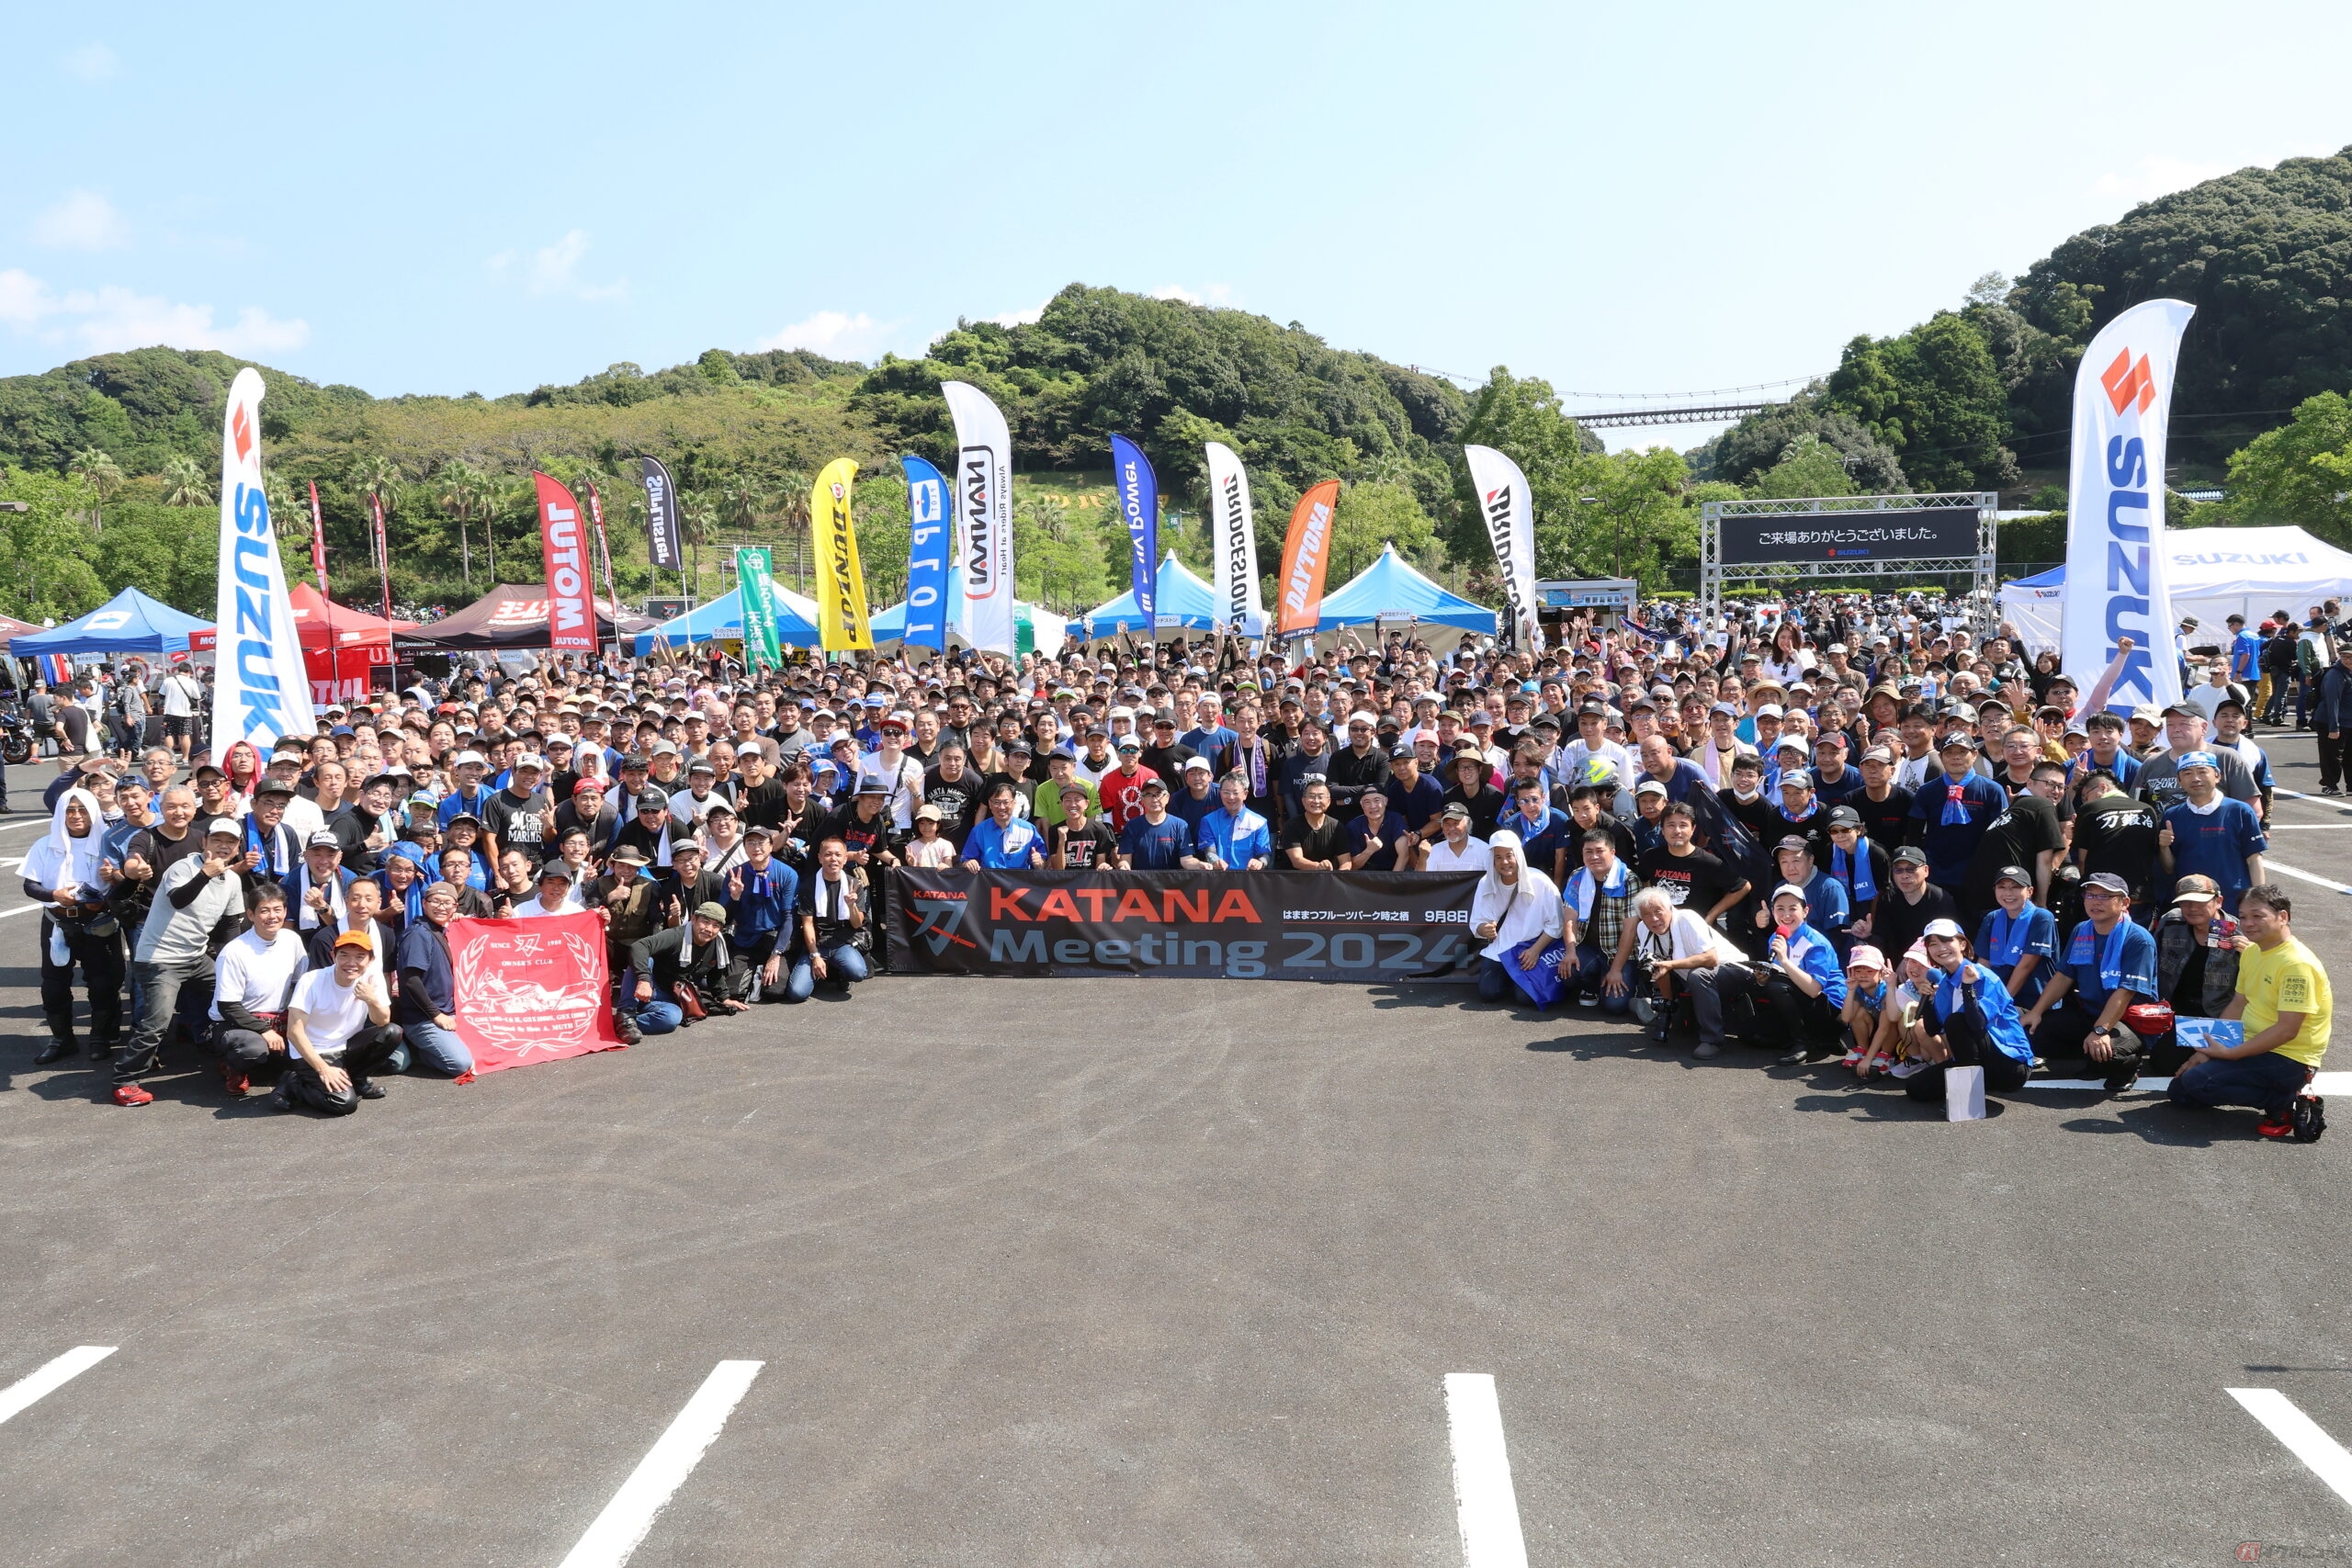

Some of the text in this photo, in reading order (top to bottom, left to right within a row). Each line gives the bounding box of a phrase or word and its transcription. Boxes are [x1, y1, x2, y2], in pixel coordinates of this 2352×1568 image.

[1758, 526, 1938, 546] ご来場ありがとうございました。
[1285, 501, 1331, 615] DAYTONA
[2172, 551, 2310, 567] SUZUKI
[832, 507, 857, 643] DUNLOP
[2105, 434, 2154, 721] SUZUKI
[199, 637, 216, 645] MO
[928, 787, 945, 799] SANTA
[2100, 815, 2154, 829] 刀鍛冶
[1655, 869, 1691, 881] KATANA
[913, 889, 967, 899] KATANA
[990, 886, 1262, 923] KATANA
[1283, 909, 1468, 923] はままつフルーツパーク時之栖 9月8日
[989, 929, 1475, 977] Meeting 2024
